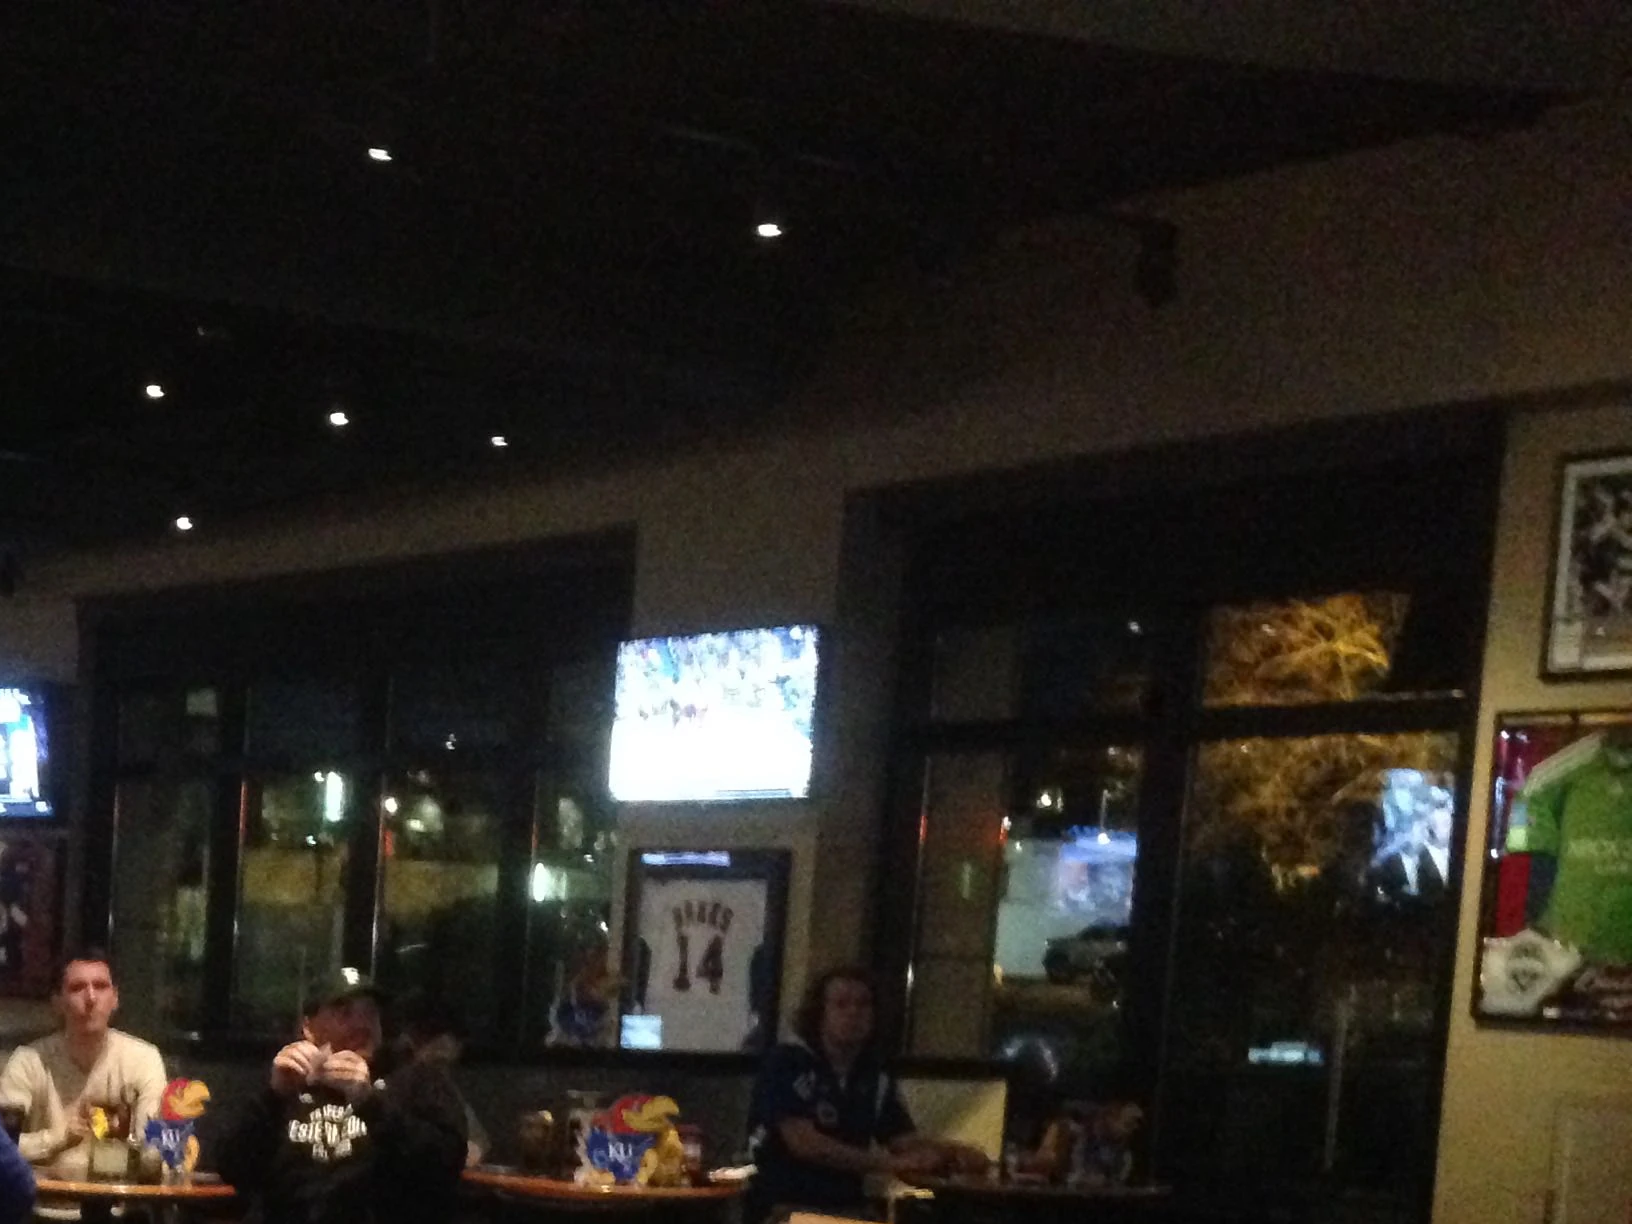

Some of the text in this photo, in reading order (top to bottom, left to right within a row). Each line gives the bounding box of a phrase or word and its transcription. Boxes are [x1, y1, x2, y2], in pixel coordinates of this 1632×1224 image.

[672, 932, 724, 995] 14
[161, 1127, 181, 1150] KU
[608, 1142, 634, 1163] KU
